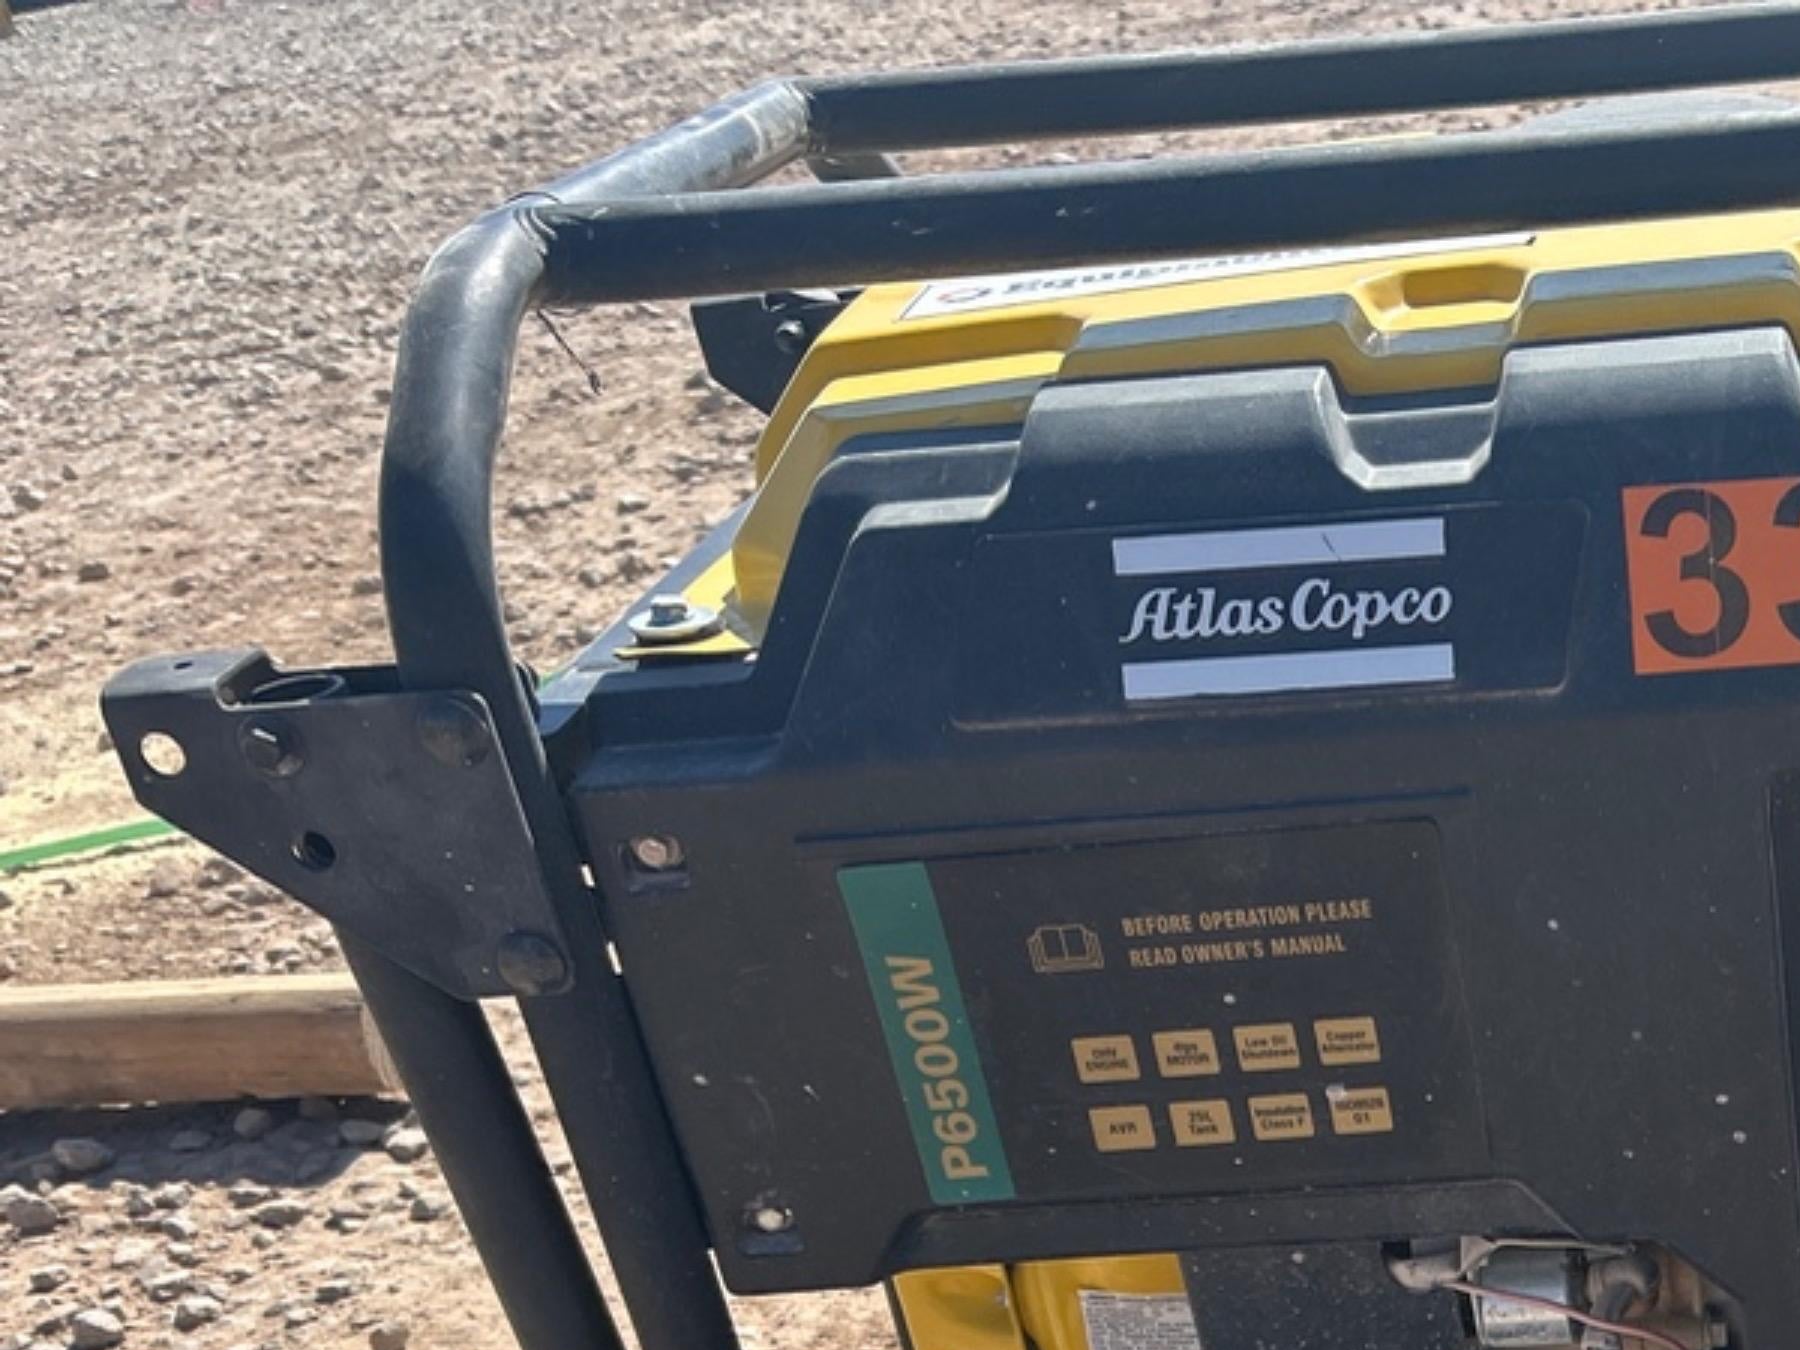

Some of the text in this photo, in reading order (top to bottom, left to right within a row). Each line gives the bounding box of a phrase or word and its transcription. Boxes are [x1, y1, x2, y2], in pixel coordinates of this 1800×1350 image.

[1119, 578, 1452, 643] Atlas Copco
[1121, 898, 1373, 937] BEFORE OPERATION PLEASE
[1129, 932, 1347, 968] READ OWNER'S MANUAL
[884, 955, 990, 1181] P6500W
